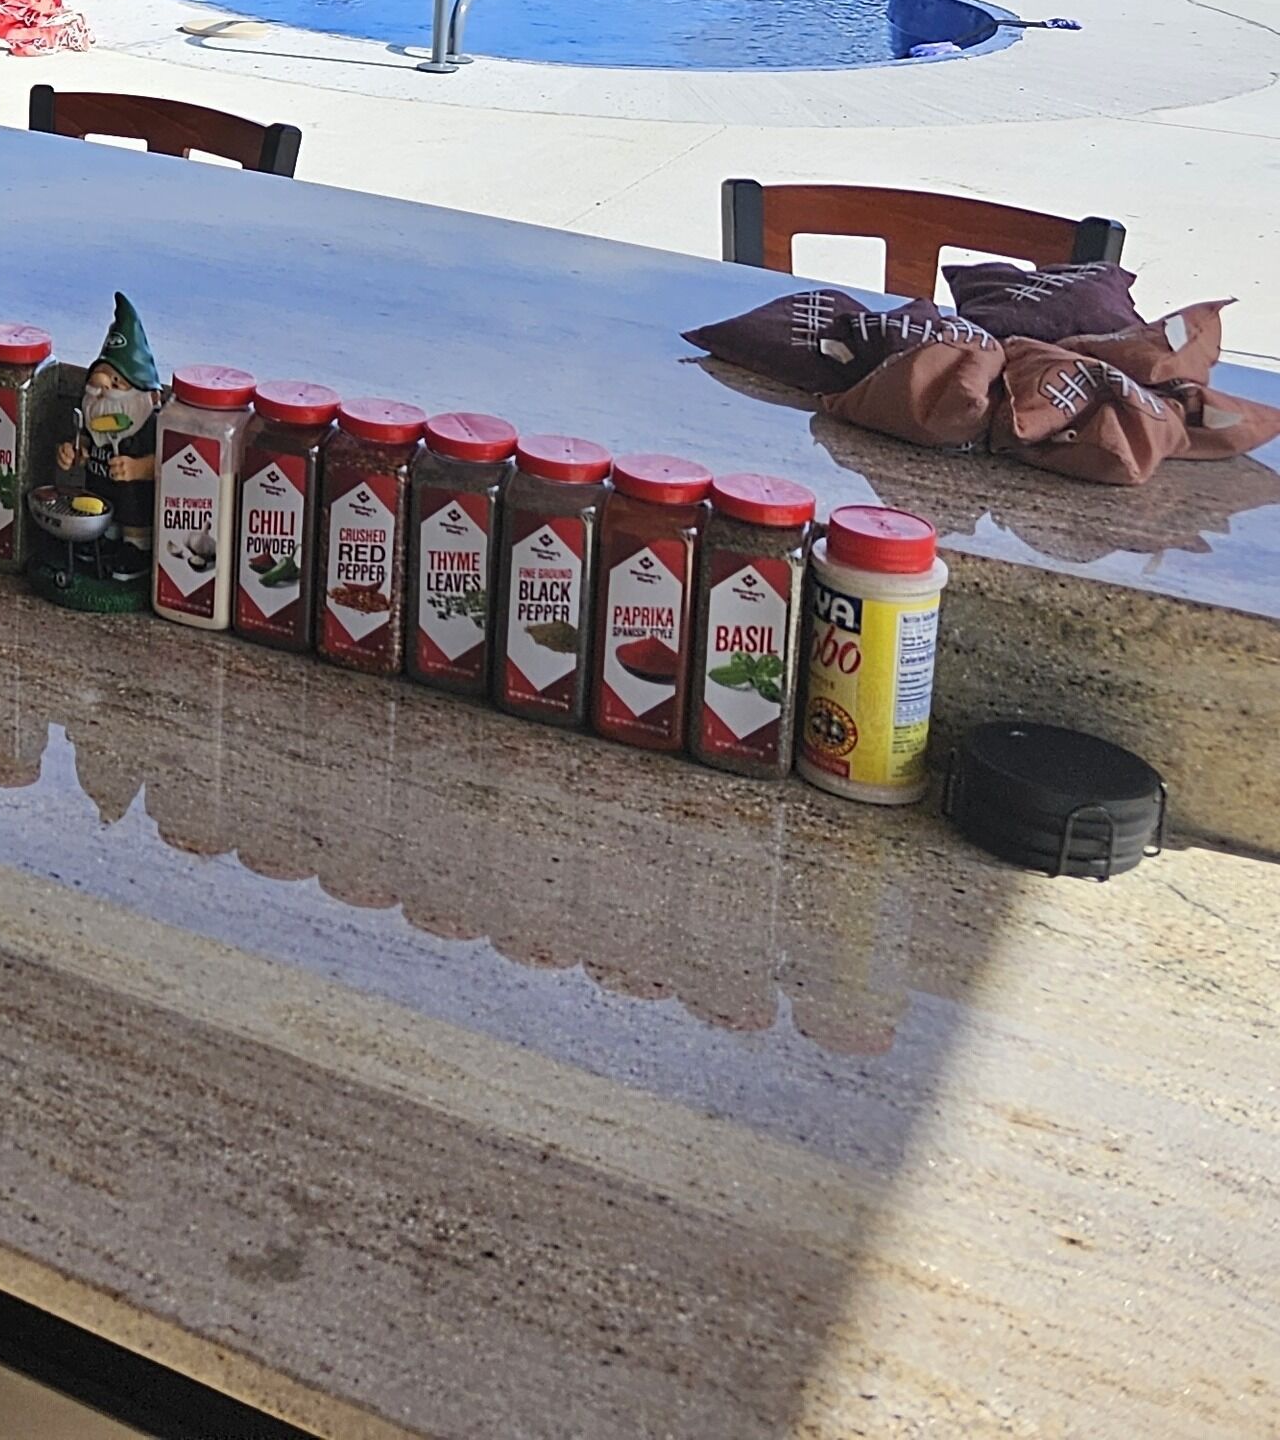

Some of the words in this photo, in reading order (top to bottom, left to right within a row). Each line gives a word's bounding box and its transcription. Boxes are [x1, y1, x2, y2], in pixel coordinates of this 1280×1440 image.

[164, 496, 180, 509] FINE
[182, 497, 213, 509] POWDER
[164, 509, 213, 530] GARLIC
[248, 509, 295, 537] CHILI
[339, 528, 386, 543] CRUSHED
[246, 537, 296, 555] POWDER
[338, 543, 386, 563] RED
[427, 550, 480, 572] THYME
[337, 563, 385, 582] PEPPER
[427, 572, 481, 593] LEAVES
[519, 567, 537, 579] FINE
[539, 568, 572, 580] GROUND
[518, 580, 571, 603] BLACK
[518, 603, 570, 622] PEPPER
[613, 606, 674, 627] PAPRIKA
[612, 627, 647, 638] SPANISH
[649, 628, 673, 639] STYLE
[715, 624, 778, 654] BASIL
